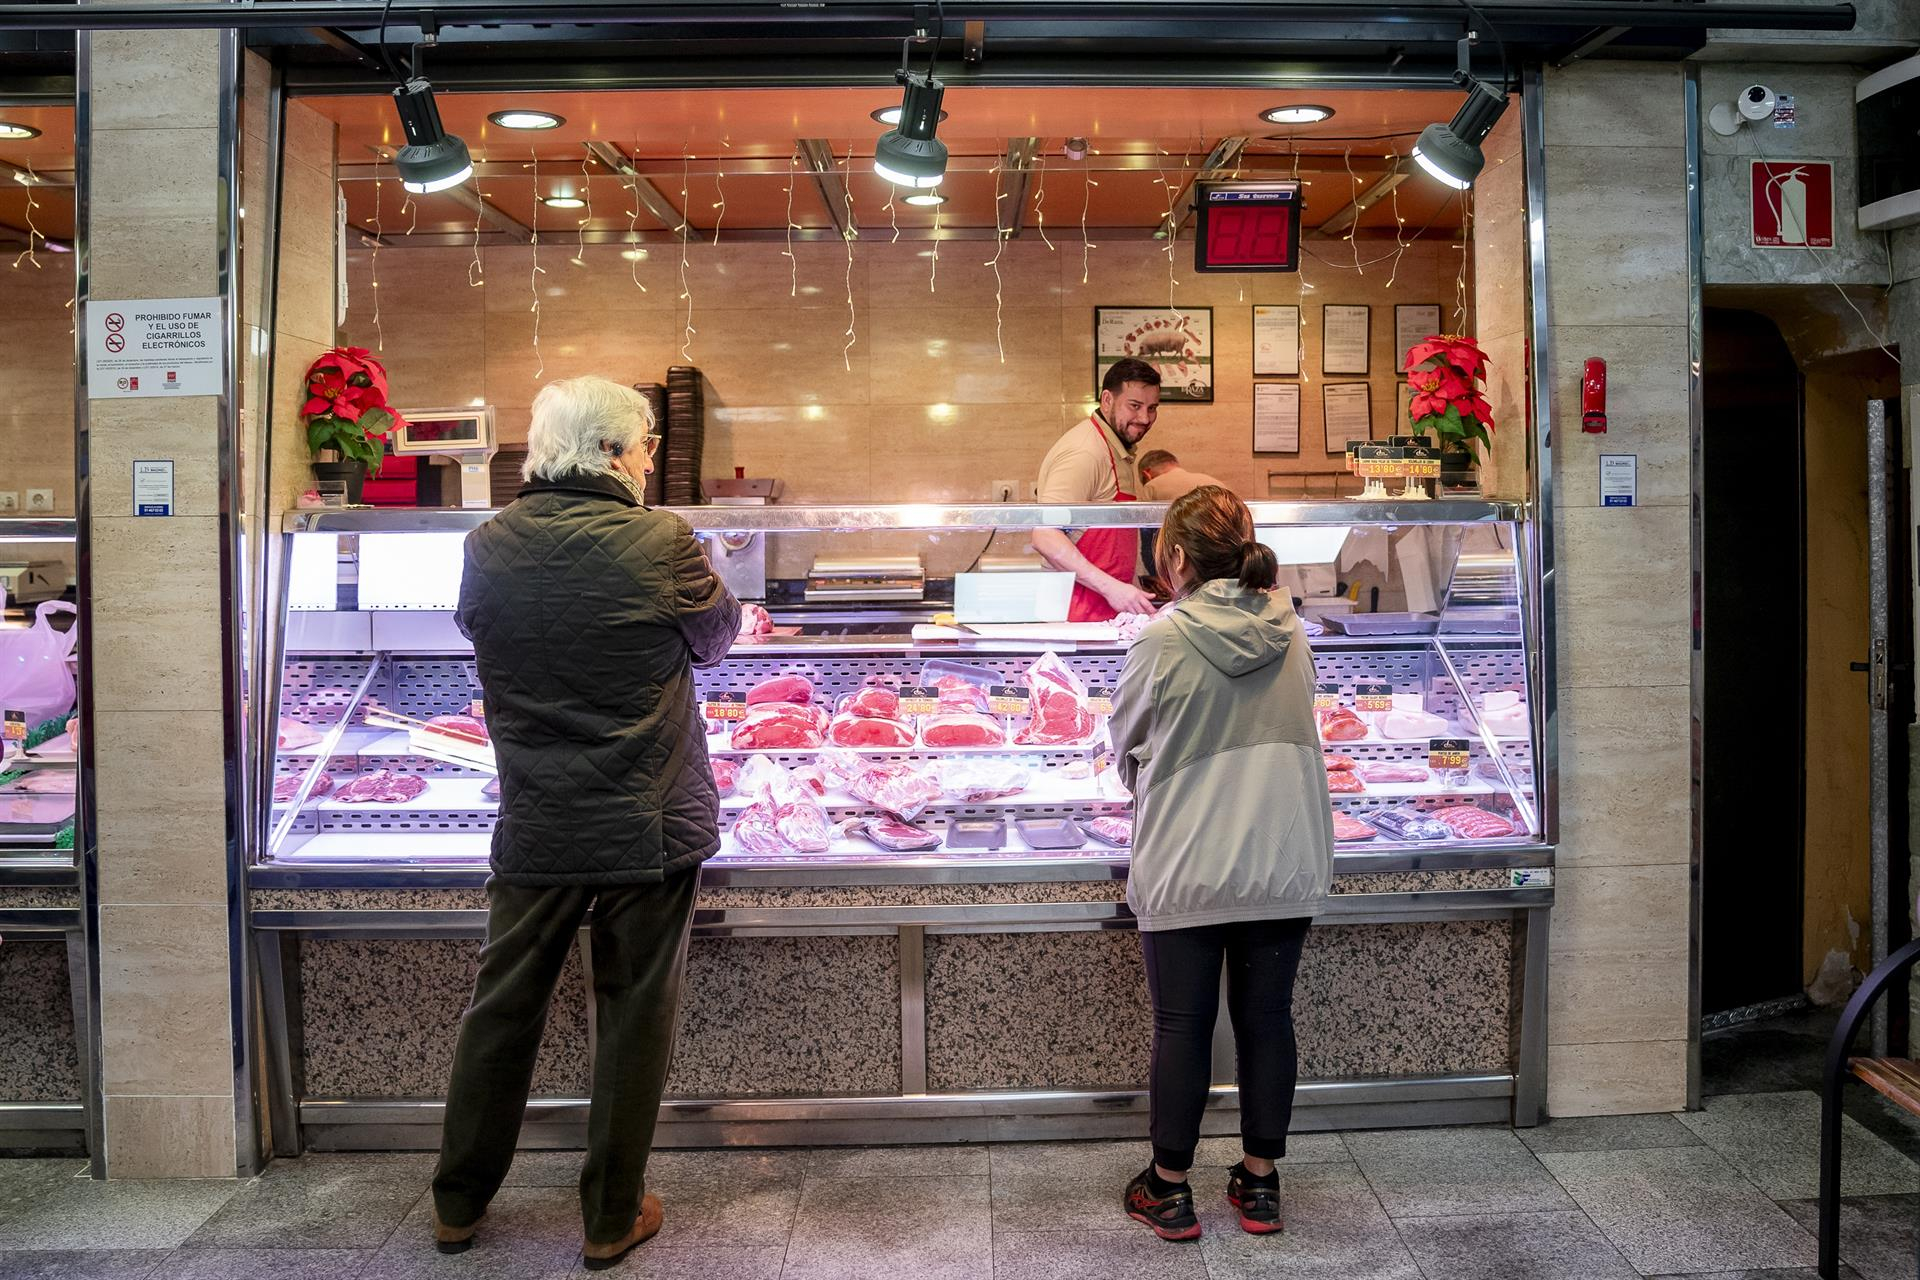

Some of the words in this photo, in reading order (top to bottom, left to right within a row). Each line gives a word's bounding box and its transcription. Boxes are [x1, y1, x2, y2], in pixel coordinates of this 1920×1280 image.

[135, 313, 180, 321] PROHIBIDO
[183, 312, 212, 320] FUMAR
[187, 321, 199, 329] DE
[146, 331, 202, 339] CIGARRILLOS
[142, 339, 206, 349] ELECTRÓNICOS
